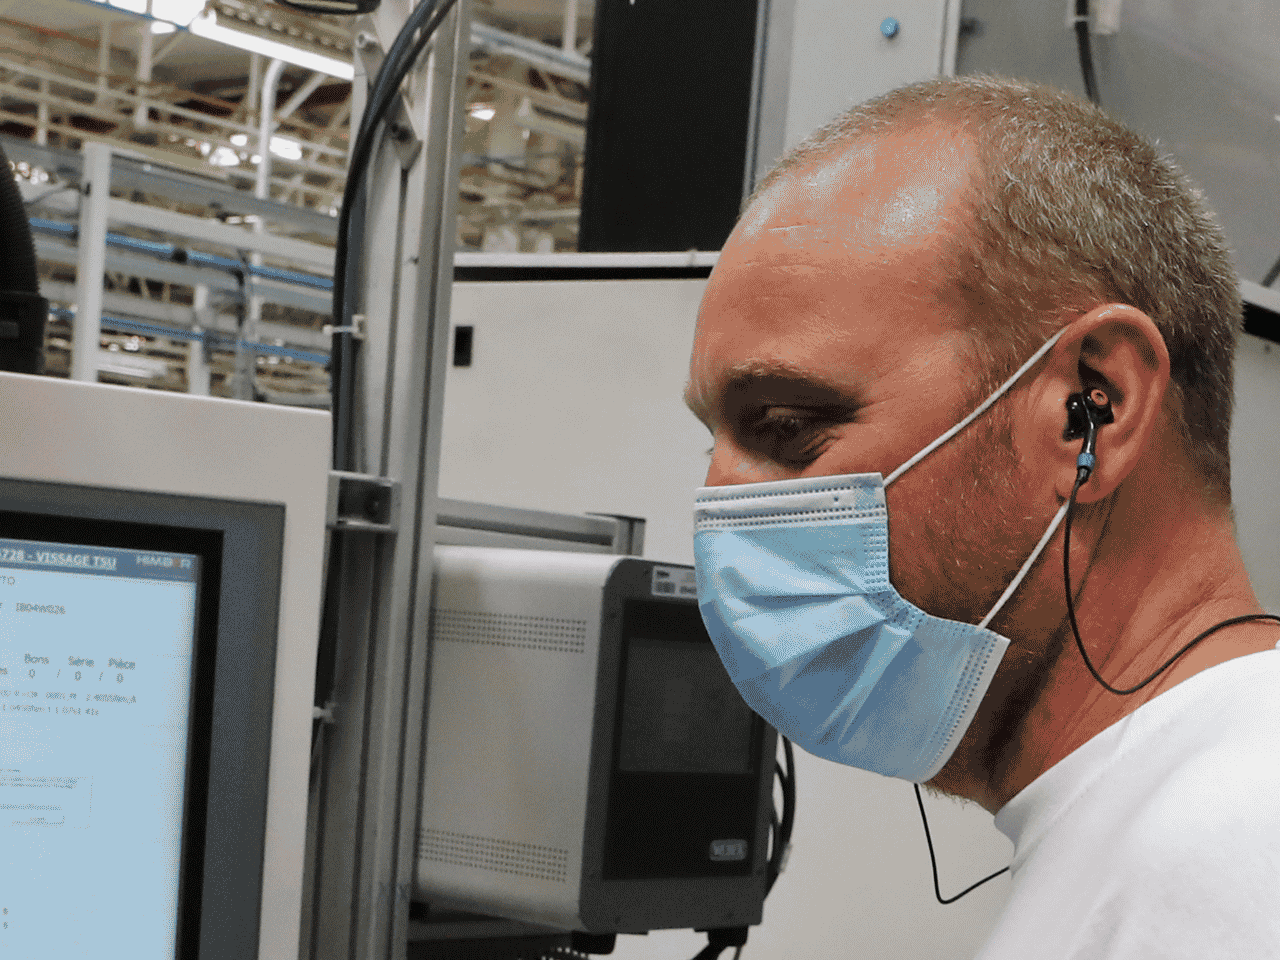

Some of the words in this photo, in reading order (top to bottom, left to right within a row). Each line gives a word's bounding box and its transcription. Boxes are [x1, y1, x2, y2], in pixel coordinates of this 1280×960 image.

[37, 551, 91, 567] VISSAGE
[93, 555, 117, 569] TSU
[24, 653, 50, 665] Bons
